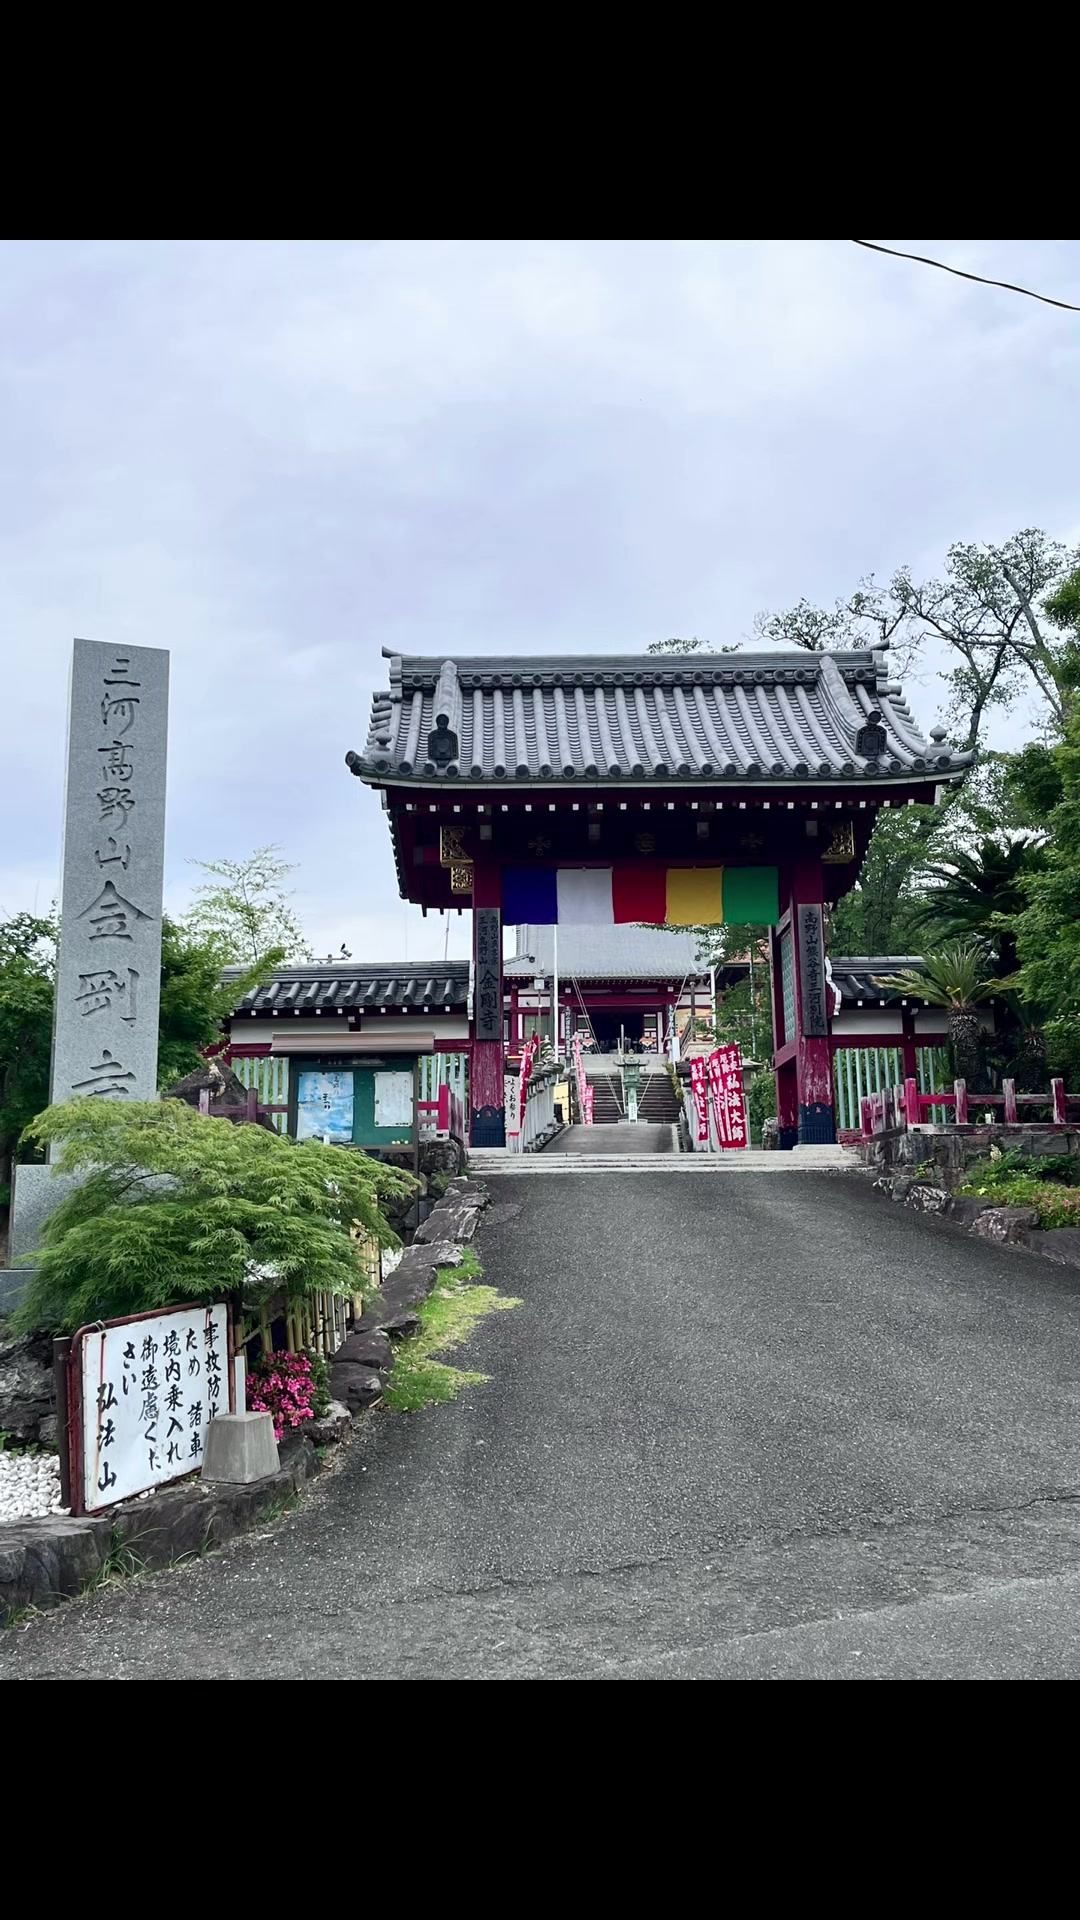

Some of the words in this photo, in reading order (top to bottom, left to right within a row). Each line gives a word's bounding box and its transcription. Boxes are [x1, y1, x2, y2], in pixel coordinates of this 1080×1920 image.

[480, 969, 499, 1031] 金剛寺
[727, 1073, 744, 1141] 弘法大師
[122, 1342, 136, 1395] さい
[186, 1328, 200, 1377] ため
[203, 1321, 222, 1425] 事故防止
[138, 1335, 161, 1470] 御遠慮くだ
[163, 1330, 184, 1465] 境内乗入れ
[187, 1401, 203, 1458] 諸車
[96, 1383, 118, 1491] 弘法山
